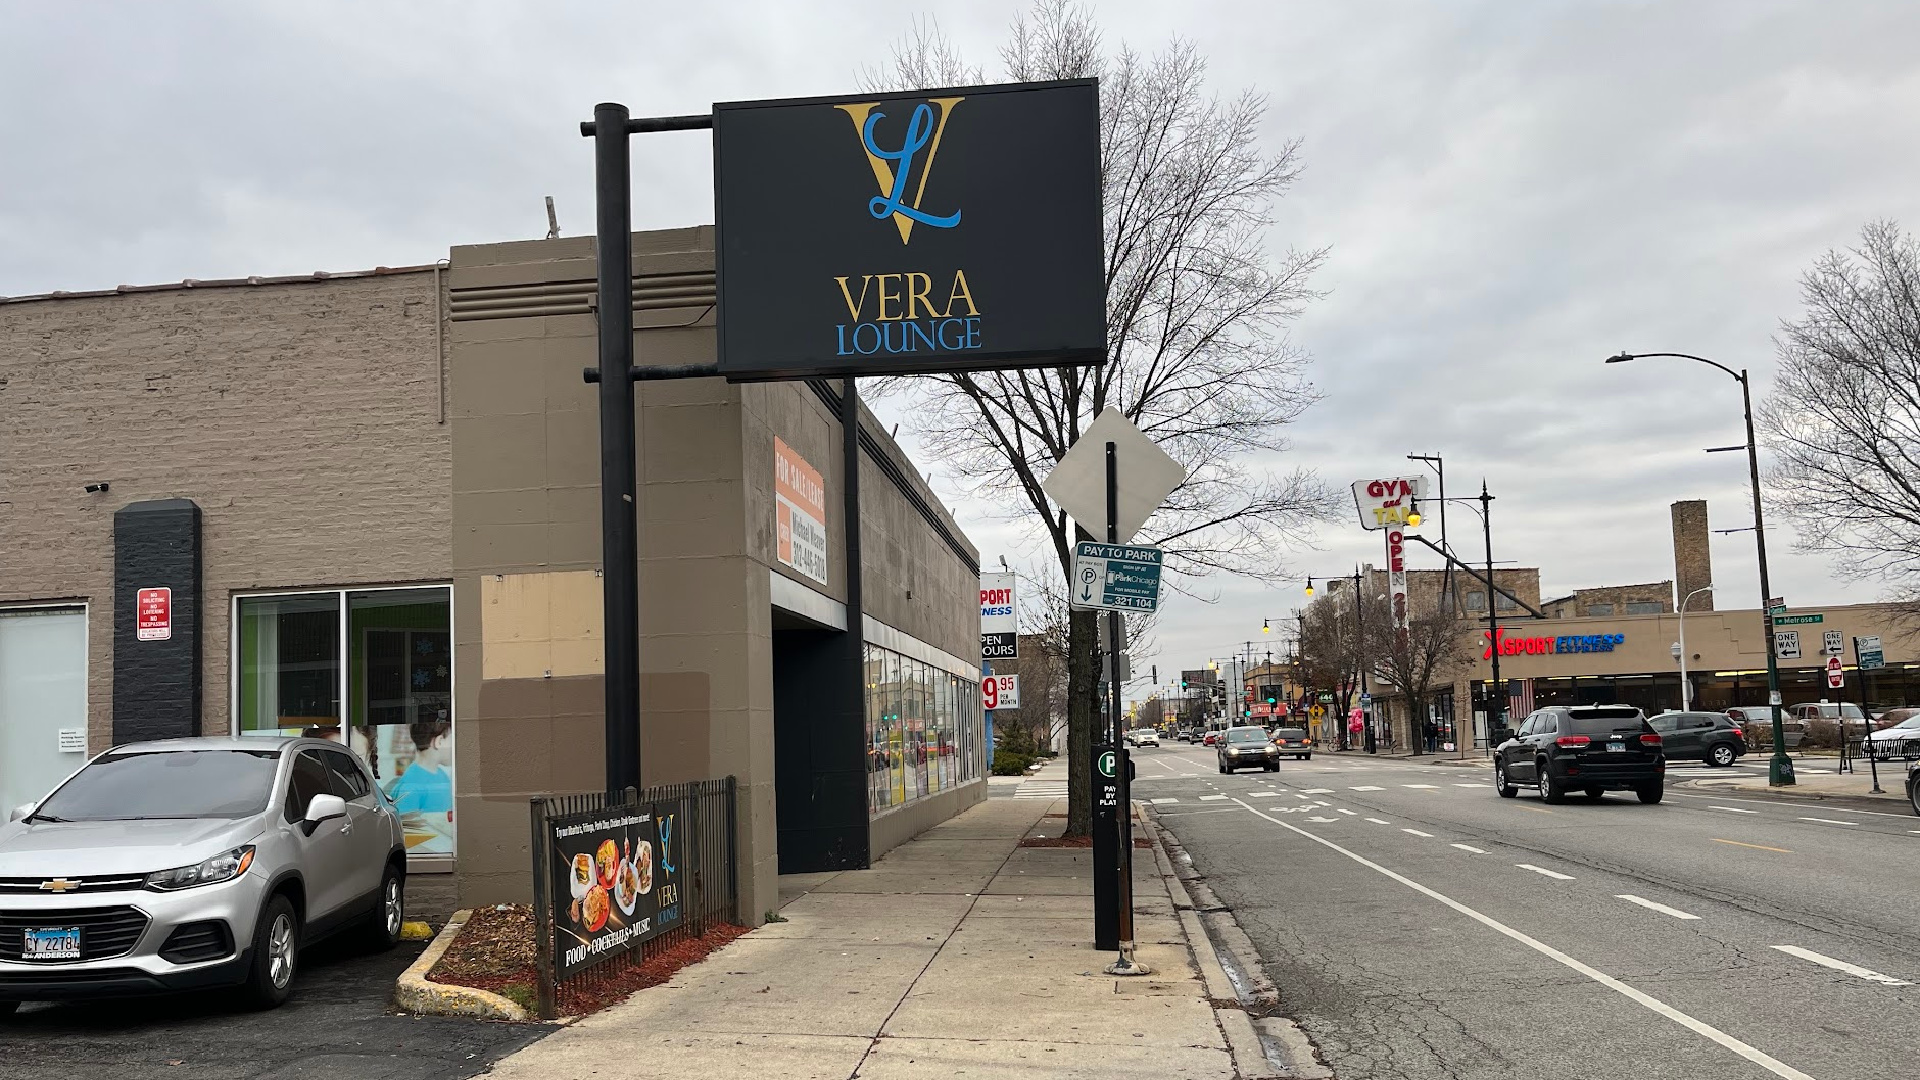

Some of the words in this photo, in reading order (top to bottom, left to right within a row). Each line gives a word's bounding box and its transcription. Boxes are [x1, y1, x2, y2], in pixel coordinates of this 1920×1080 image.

[834, 269, 981, 323] VERA
[836, 318, 982, 356] LOUNGE
[776, 451, 789, 485] FOR
[1383, 495, 1402, 508] and
[1084, 546, 1105, 556] PAY
[1107, 548, 1122, 558] TO
[1125, 549, 1156, 561] PARK
[1389, 531, 1405, 586] OPEN
[1115, 596, 1132, 605] 321
[1135, 599, 1152, 608] 104
[981, 607, 1012, 615] NESS
[1556, 633, 1625, 647] FITNESS
[982, 645, 1014, 656] OURS
[1555, 644, 1615, 655] EXPRESS
[1106, 755, 1115, 773] P
[657, 883, 678, 908] VERA
[25, 936, 39, 951] CY
[566, 944, 587, 968] FOOD
[591, 927, 630, 956] COCKTAILS
[632, 917, 651, 937] MUSIC
[34, 951, 80, 959] ANDERSON
